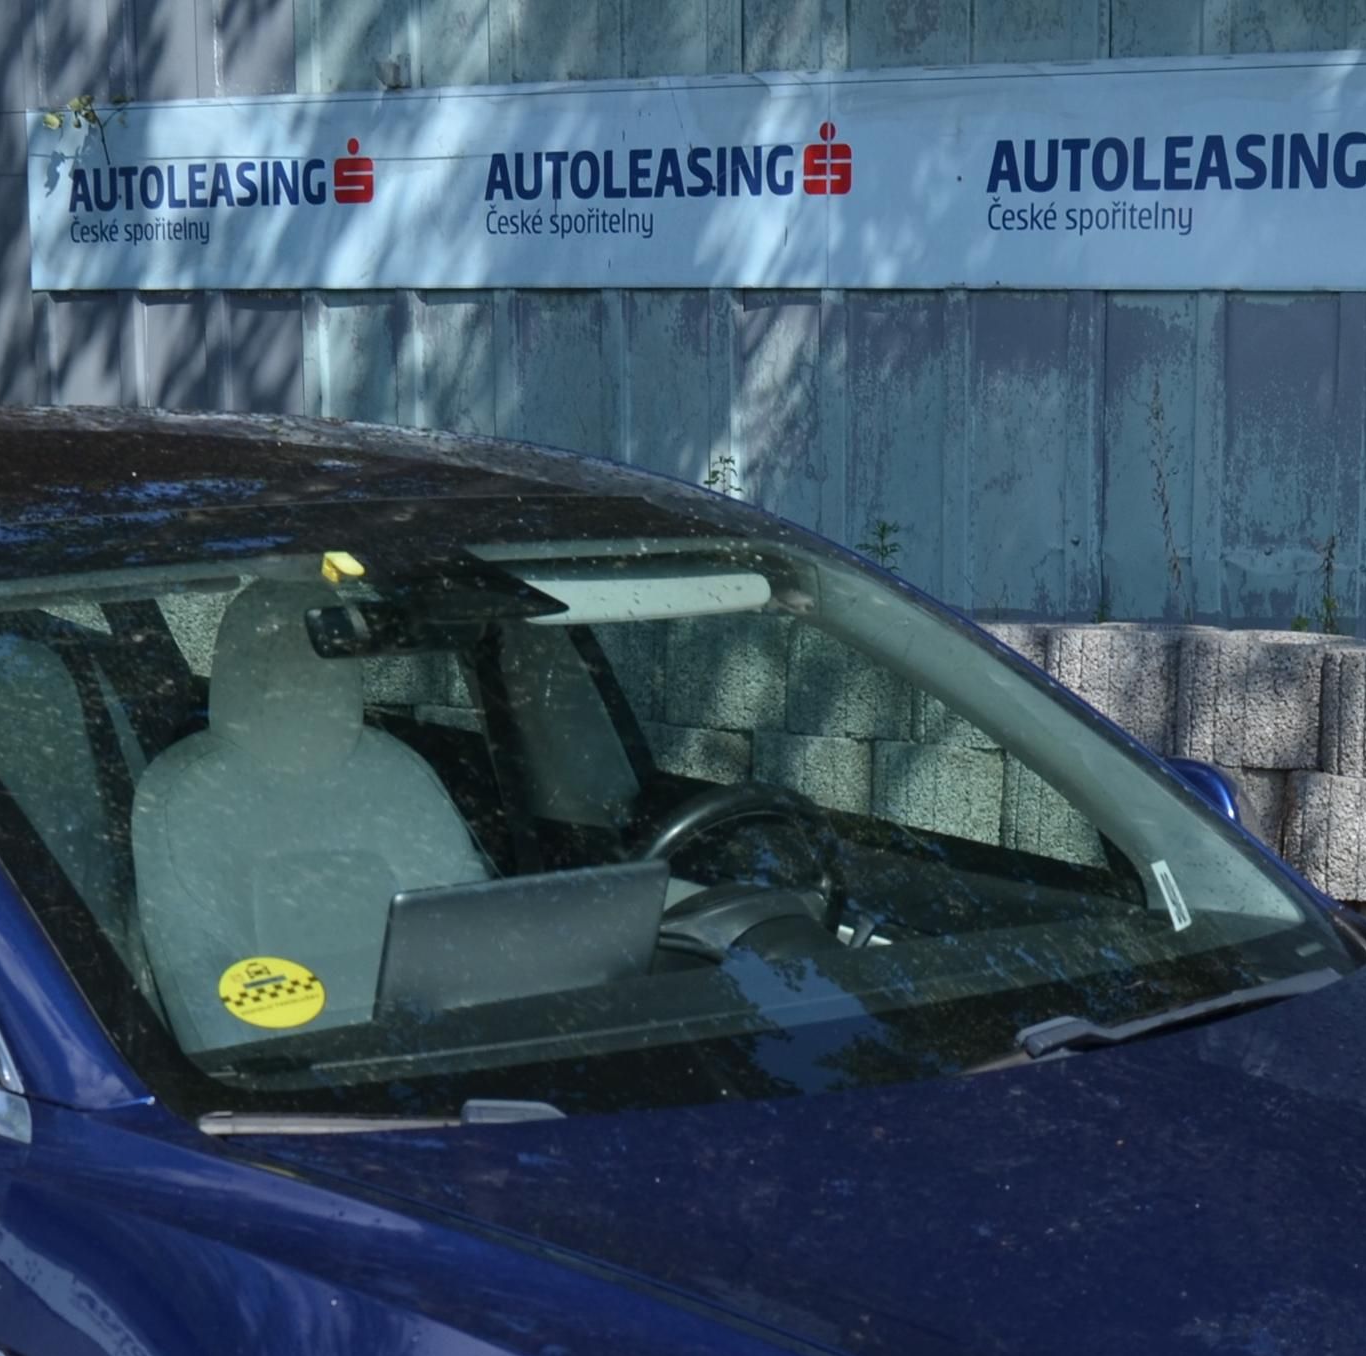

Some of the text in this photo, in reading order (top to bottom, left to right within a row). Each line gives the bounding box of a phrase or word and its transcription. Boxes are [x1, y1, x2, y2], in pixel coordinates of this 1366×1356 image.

[69, 158, 327, 213] AUTOLEASING
[485, 144, 796, 201] AUTOLEASING
[70, 210, 211, 246] České spořitelny
[486, 204, 654, 240] České spořitelny
[986, 191, 1193, 236] České spořitelny
